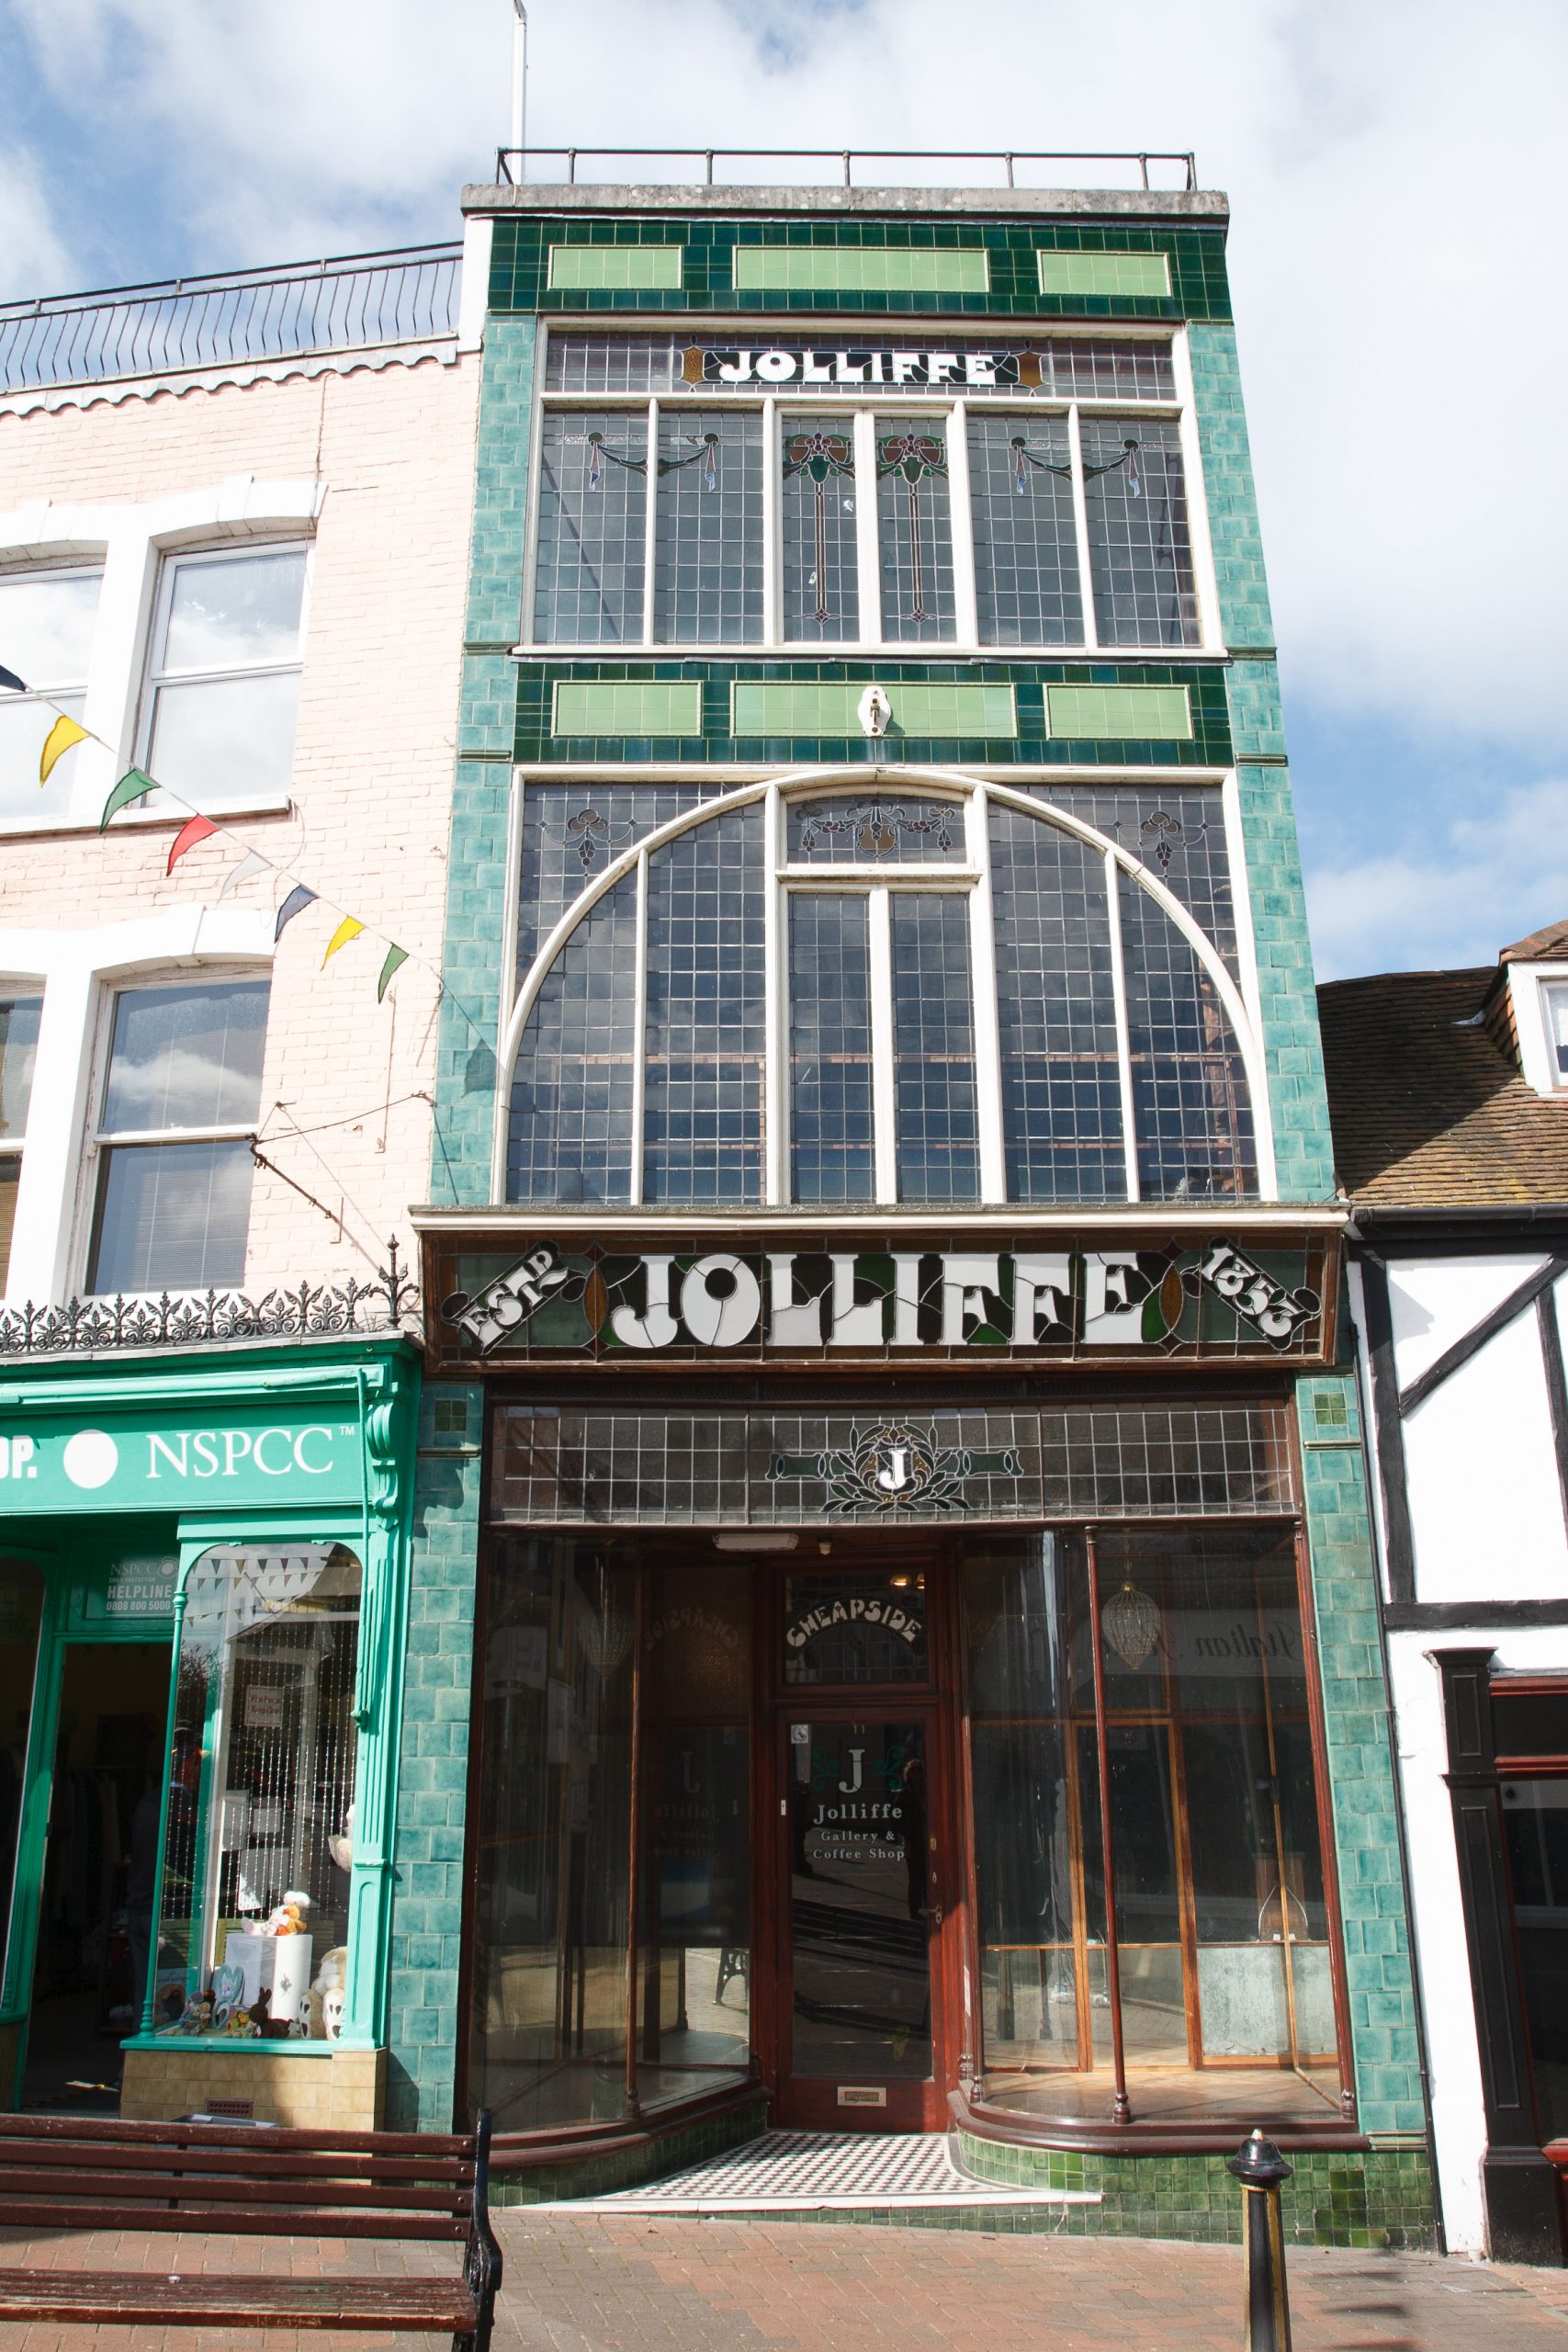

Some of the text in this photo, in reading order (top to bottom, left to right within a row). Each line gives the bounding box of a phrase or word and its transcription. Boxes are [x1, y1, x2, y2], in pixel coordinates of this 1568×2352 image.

[719, 351, 997, 384] JOLLIFFE
[459, 1250, 569, 1345] ESTD
[611, 1252, 1145, 1349] JOLLIFFE
[1201, 1247, 1300, 1338] 1853
[146, 1427, 334, 1478] NSPCC
[878, 1448, 907, 1490] J
[110, 1563, 158, 1576] NSPCC
[106, 1600, 171, 1611] 0808 800 5000
[107, 1585, 173, 1599] HELPLINE
[786, 1599, 922, 1647] CHEAPSIDE
[839, 1748, 866, 1793] J
[813, 1804, 903, 1825] Jolliffe
[813, 1848, 906, 1861] Coffee Shop
[821, 1830, 897, 1844] Gallery &
